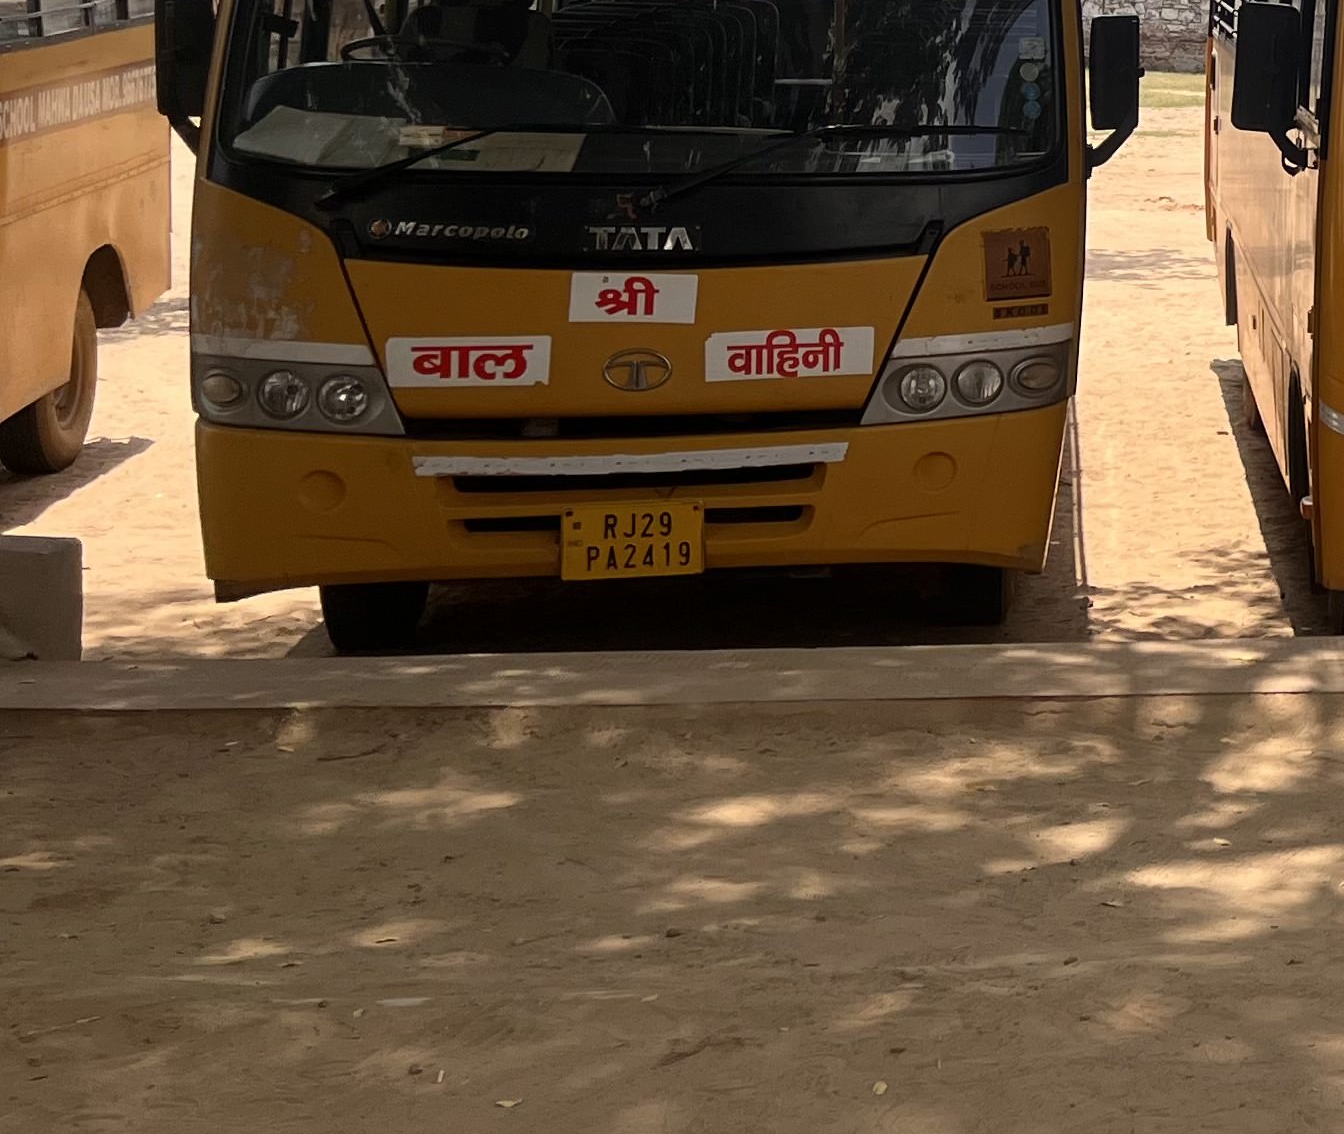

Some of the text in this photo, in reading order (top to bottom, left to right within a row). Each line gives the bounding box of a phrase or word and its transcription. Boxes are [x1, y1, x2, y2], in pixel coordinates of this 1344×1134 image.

[395, 220, 529, 240] Marcopolo
[588, 226, 694, 251] TATA
[594, 275, 660, 316] श्री
[410, 343, 534, 380] बाल
[726, 328, 845, 378] वाहिनी
[603, 511, 673, 539] RJ29
[586, 541, 691, 571] PA2419
